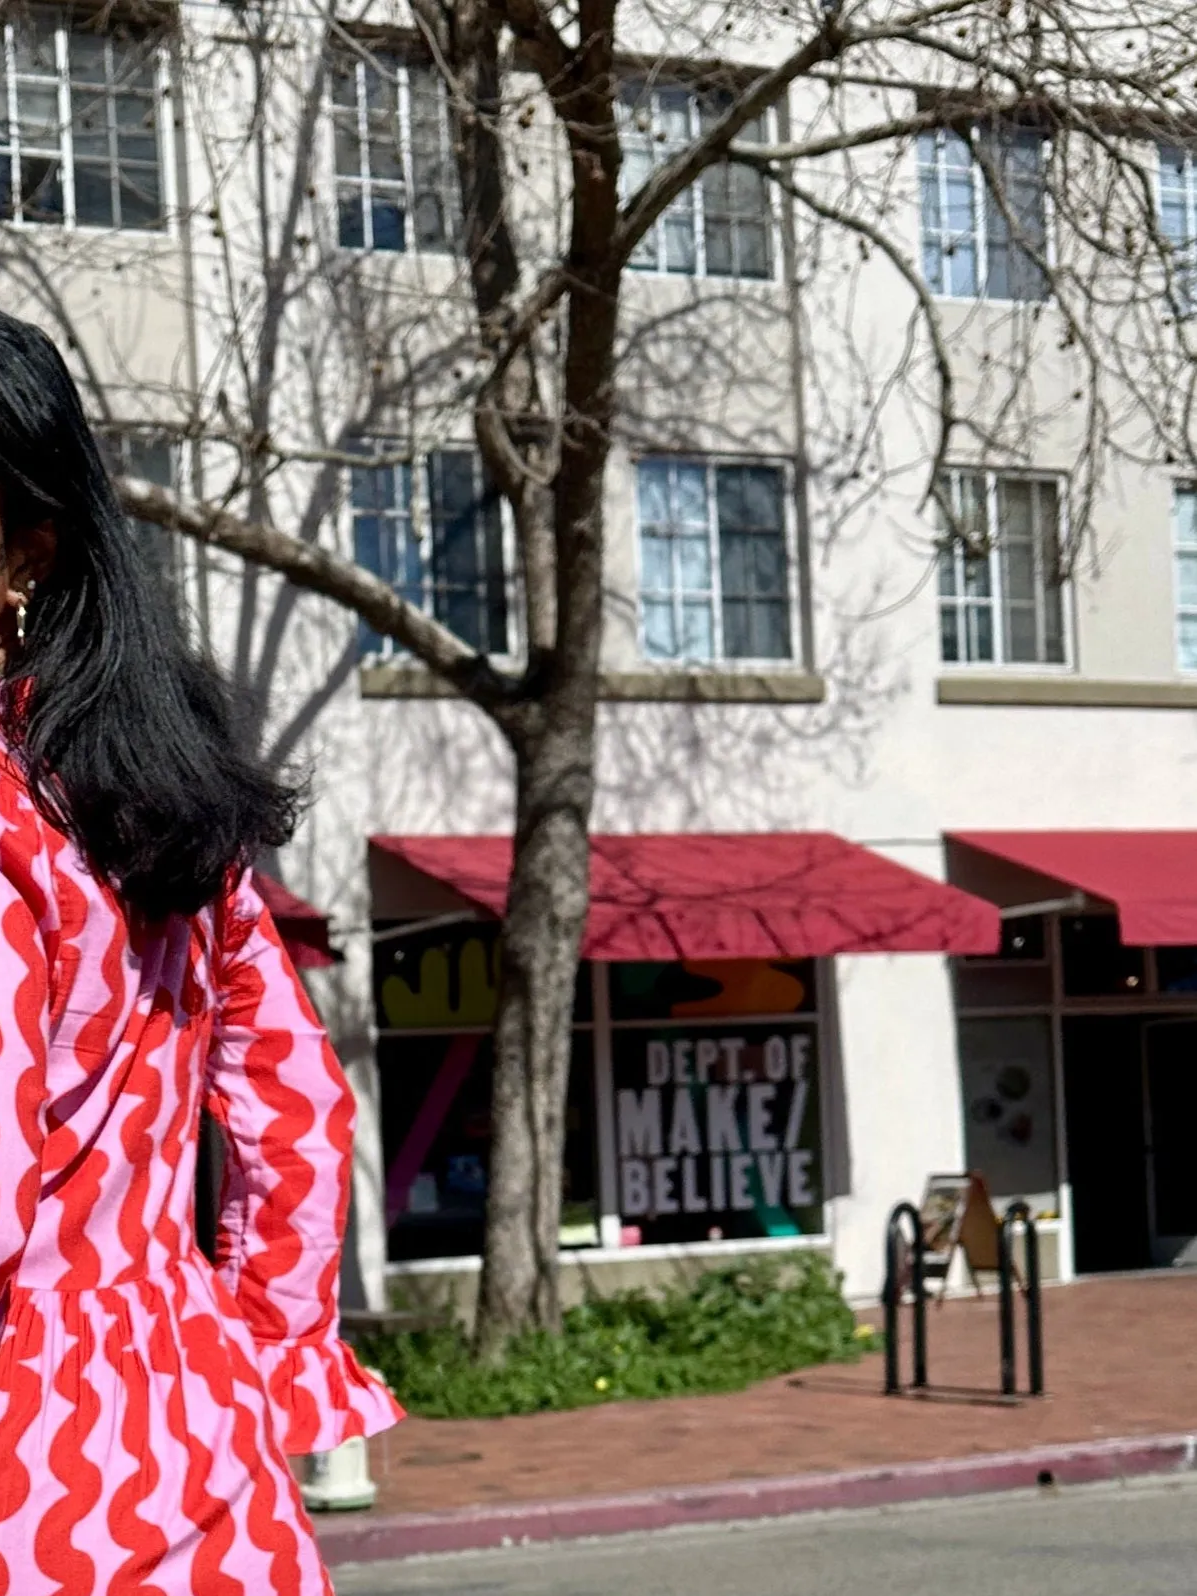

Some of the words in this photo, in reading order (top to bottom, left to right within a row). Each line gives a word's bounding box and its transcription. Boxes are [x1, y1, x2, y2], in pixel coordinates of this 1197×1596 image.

[648, 1038, 756, 1084] DEPT.
[765, 1034, 811, 1081] OF
[617, 1079, 808, 1156] MAKE/
[622, 1152, 812, 1214] BELIEVE
